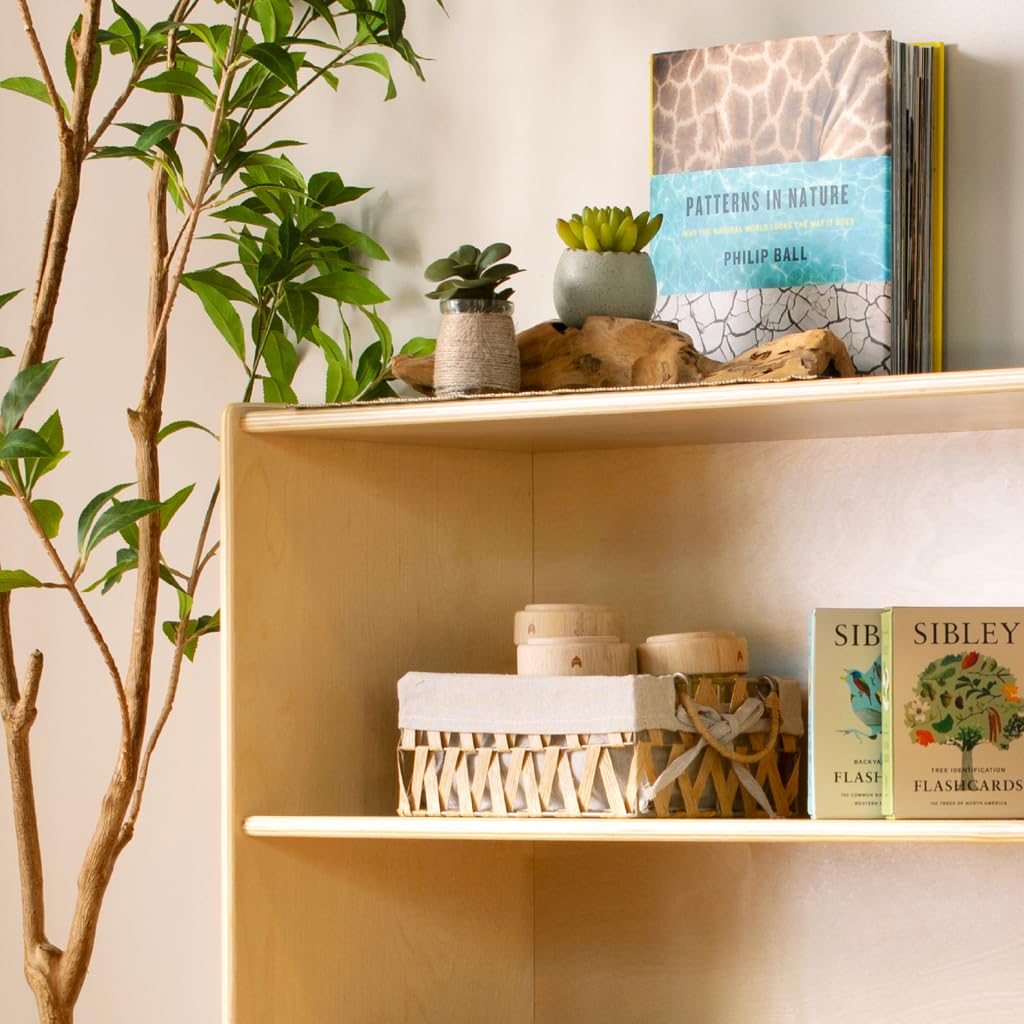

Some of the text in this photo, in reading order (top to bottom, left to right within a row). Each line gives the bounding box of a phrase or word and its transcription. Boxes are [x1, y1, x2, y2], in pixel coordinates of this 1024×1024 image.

[686, 184, 849, 216] PATTERNS IN NATURE
[724, 246, 807, 266] PHILIP BALL
[834, 624, 880, 646] SIB
[913, 622, 1021, 645] SIBLEY
[834, 771, 882, 783] FLASH
[913, 779, 1024, 792] FLASHCARDS
